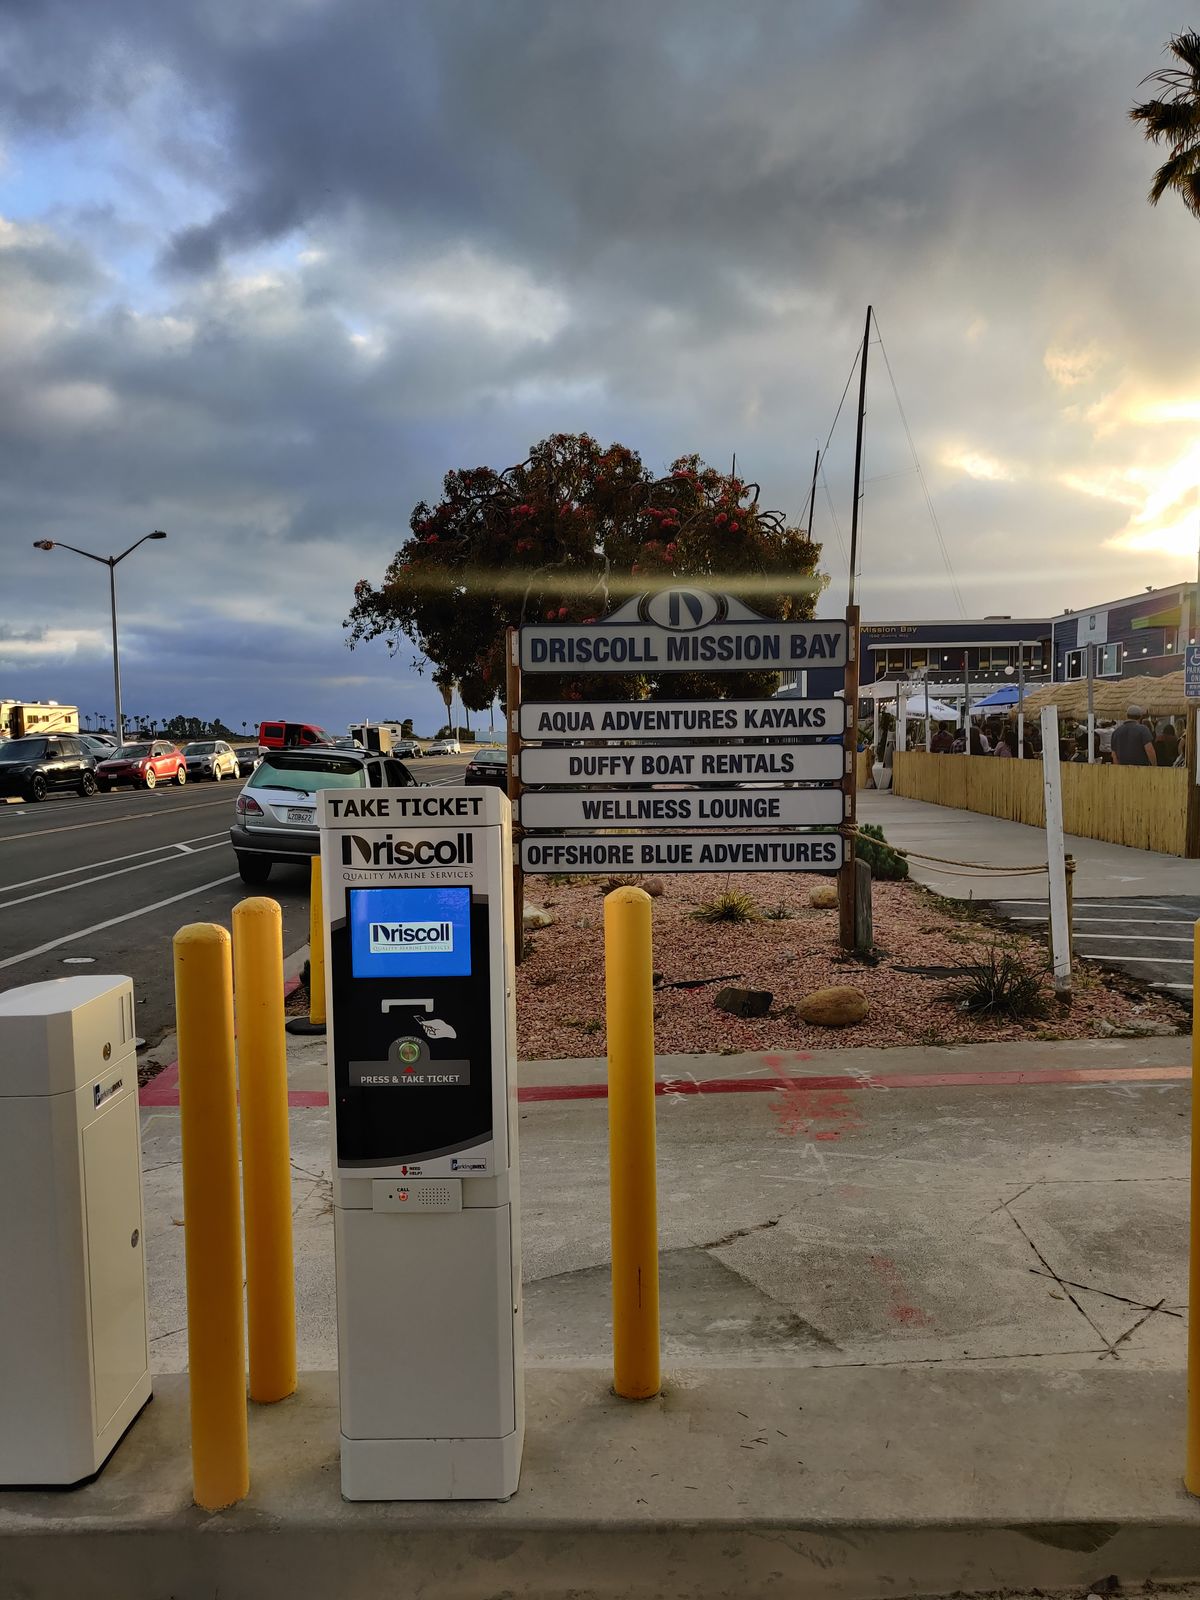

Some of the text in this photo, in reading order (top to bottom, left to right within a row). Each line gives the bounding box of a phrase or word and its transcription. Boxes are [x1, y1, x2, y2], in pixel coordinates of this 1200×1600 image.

[531, 633, 841, 663] DRISCOLL MISSION BAY
[538, 708, 826, 733] AQUA ADVENTURES KAYAKS
[569, 753, 794, 776] DUFFY BOAT RENTALS
[328, 798, 483, 817] TAKE TICKET
[582, 798, 780, 820] WELLNESS LOUNGE
[341, 833, 473, 865] Driscoll
[527, 842, 836, 865] OFFSHORE BLUE ADVENTURES
[343, 871, 474, 881] QUALITY MARINE SERVICES
[373, 923, 450, 942] Driscoll
[360, 1075, 389, 1084] PRESS
[401, 1075, 424, 1083] TAKE
[427, 1074, 460, 1083] TICKET
